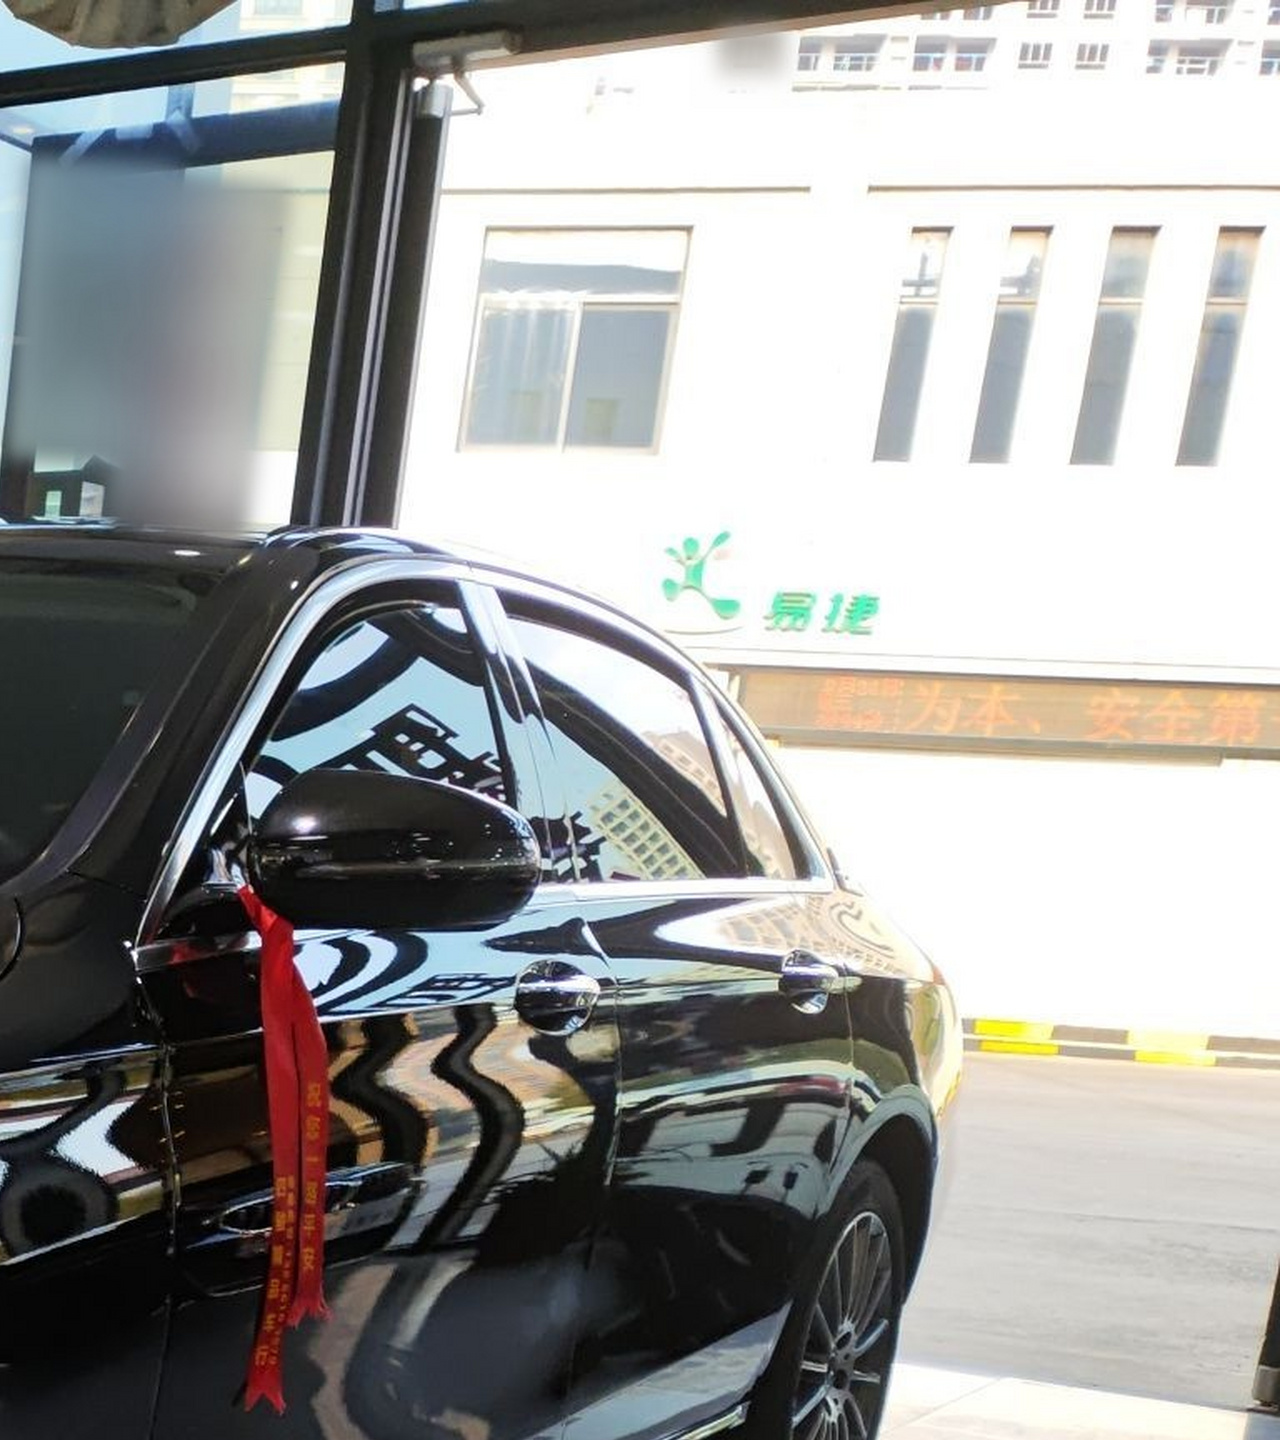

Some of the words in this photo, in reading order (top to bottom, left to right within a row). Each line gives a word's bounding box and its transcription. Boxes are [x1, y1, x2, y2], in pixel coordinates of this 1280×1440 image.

[763, 591, 880, 636] 易捷
[908, 682, 1280, 744] 为本、安全第
